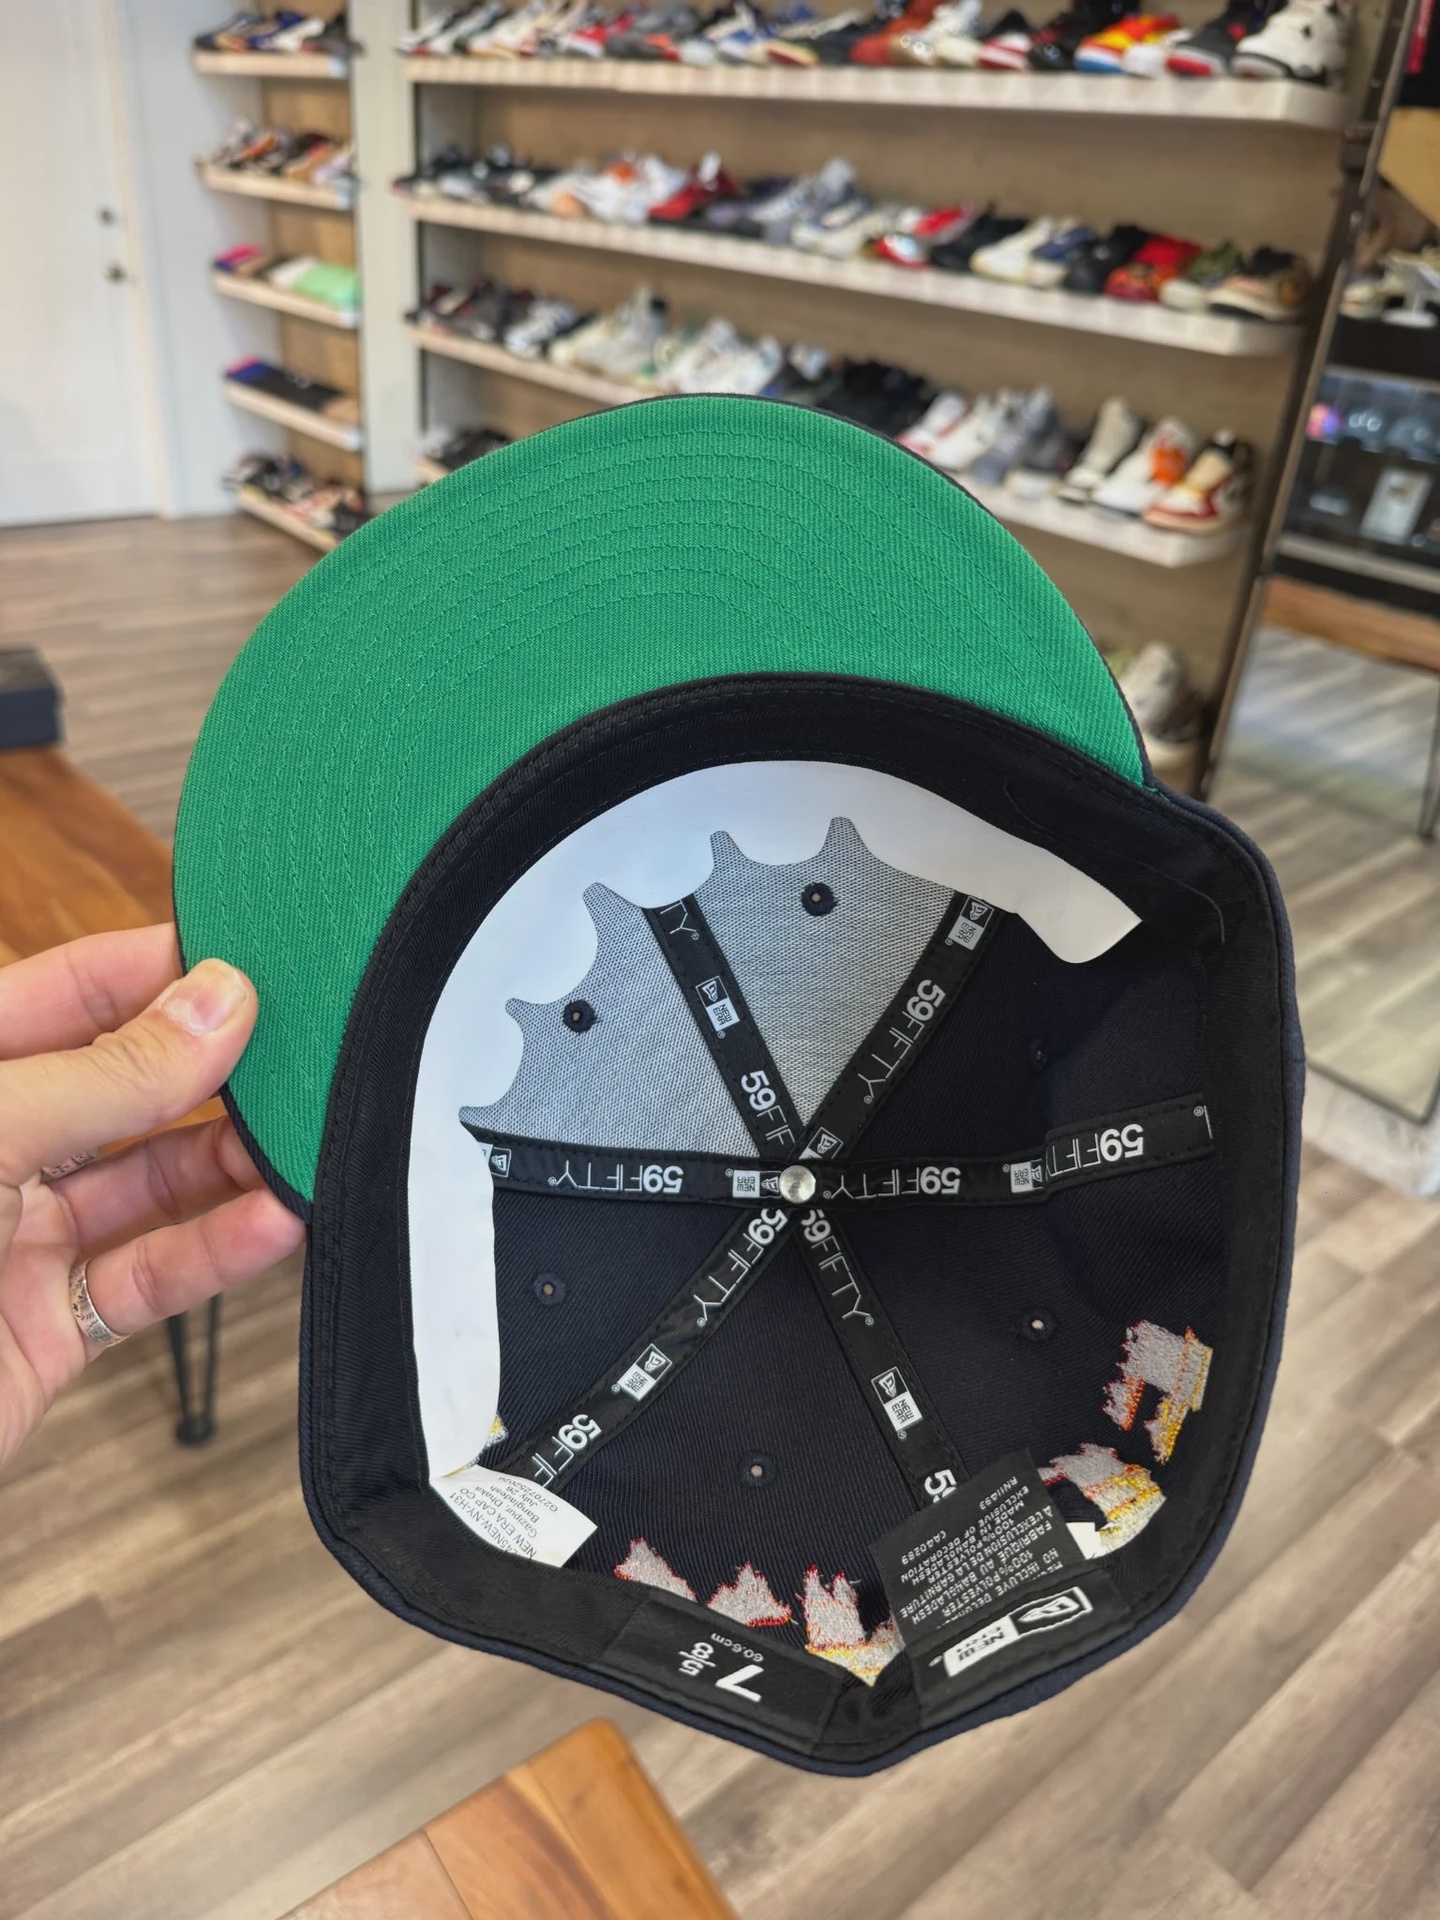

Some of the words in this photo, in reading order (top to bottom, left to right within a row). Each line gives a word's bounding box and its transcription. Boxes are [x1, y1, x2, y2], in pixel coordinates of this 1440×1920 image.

[741, 1071, 795, 1145] 59FIF
[1050, 1124, 1143, 1177] 59FIFT
[475, 1486, 503, 1508] Dhaka
[490, 1485, 540, 1524] Bangladesh
[506, 1486, 519, 1495] 26
[519, 1493, 538, 1508] July
[475, 1499, 496, 1516] CAP
[977, 1485, 1030, 1527] EXCLUSIVE
[994, 1500, 1025, 1525] MADE
[496, 1513, 516, 1536] ERA
[962, 1525, 976, 1539] OF
[979, 1523, 992, 1536] IN
[513, 1534, 537, 1558] NEW
[900, 1537, 961, 1583] DECORATION
[911, 1535, 977, 1586] BANGLADESH
[979, 1558, 995, 1574] AU
[995, 1561, 1040, 1596] INCLUYE
[899, 1572, 955, 1618] GARNITURE
[911, 1571, 978, 1625] BANGLADESH
[711, 1632, 764, 1662] 60.6cm
[715, 1664, 764, 1702] 7
